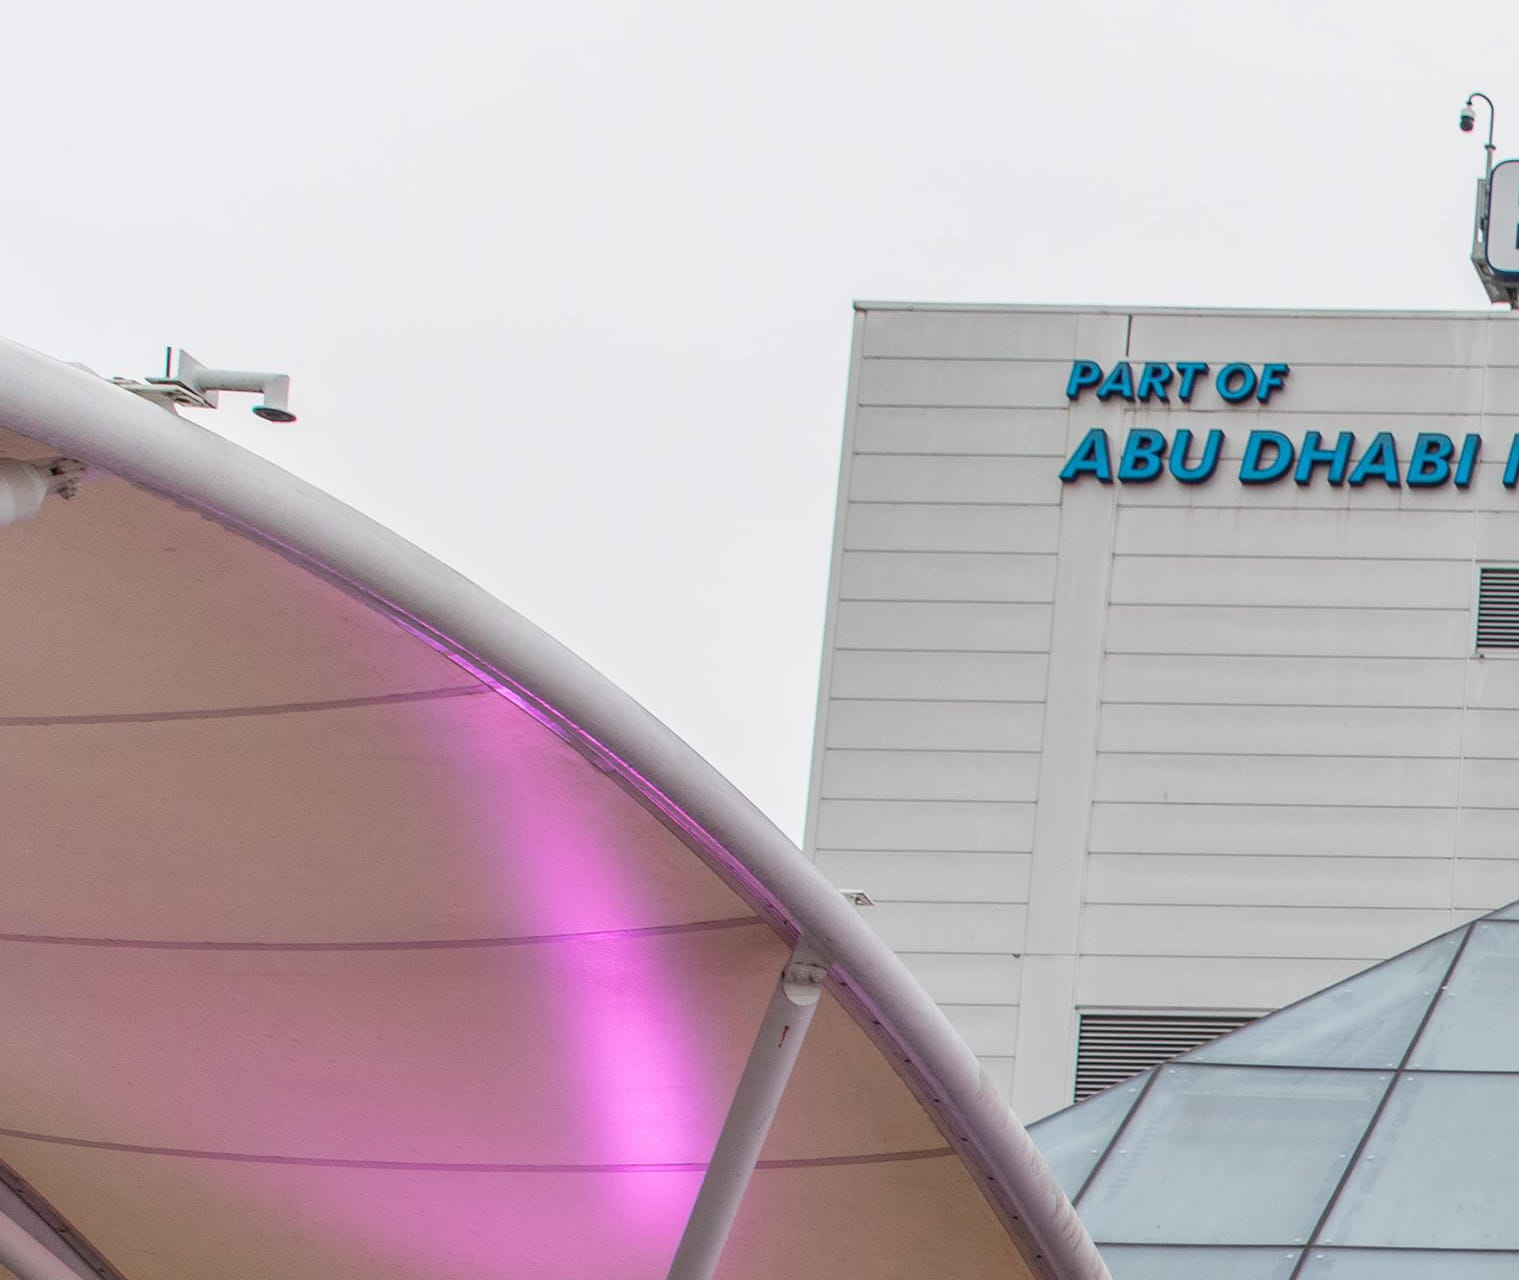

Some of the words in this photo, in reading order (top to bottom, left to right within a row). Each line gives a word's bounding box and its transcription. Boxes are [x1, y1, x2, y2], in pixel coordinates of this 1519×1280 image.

[1065, 358, 1207, 400] PART
[1215, 361, 1289, 402] OF
[1059, 428, 1223, 484] ABU
[1238, 430, 1481, 487] DHABI
